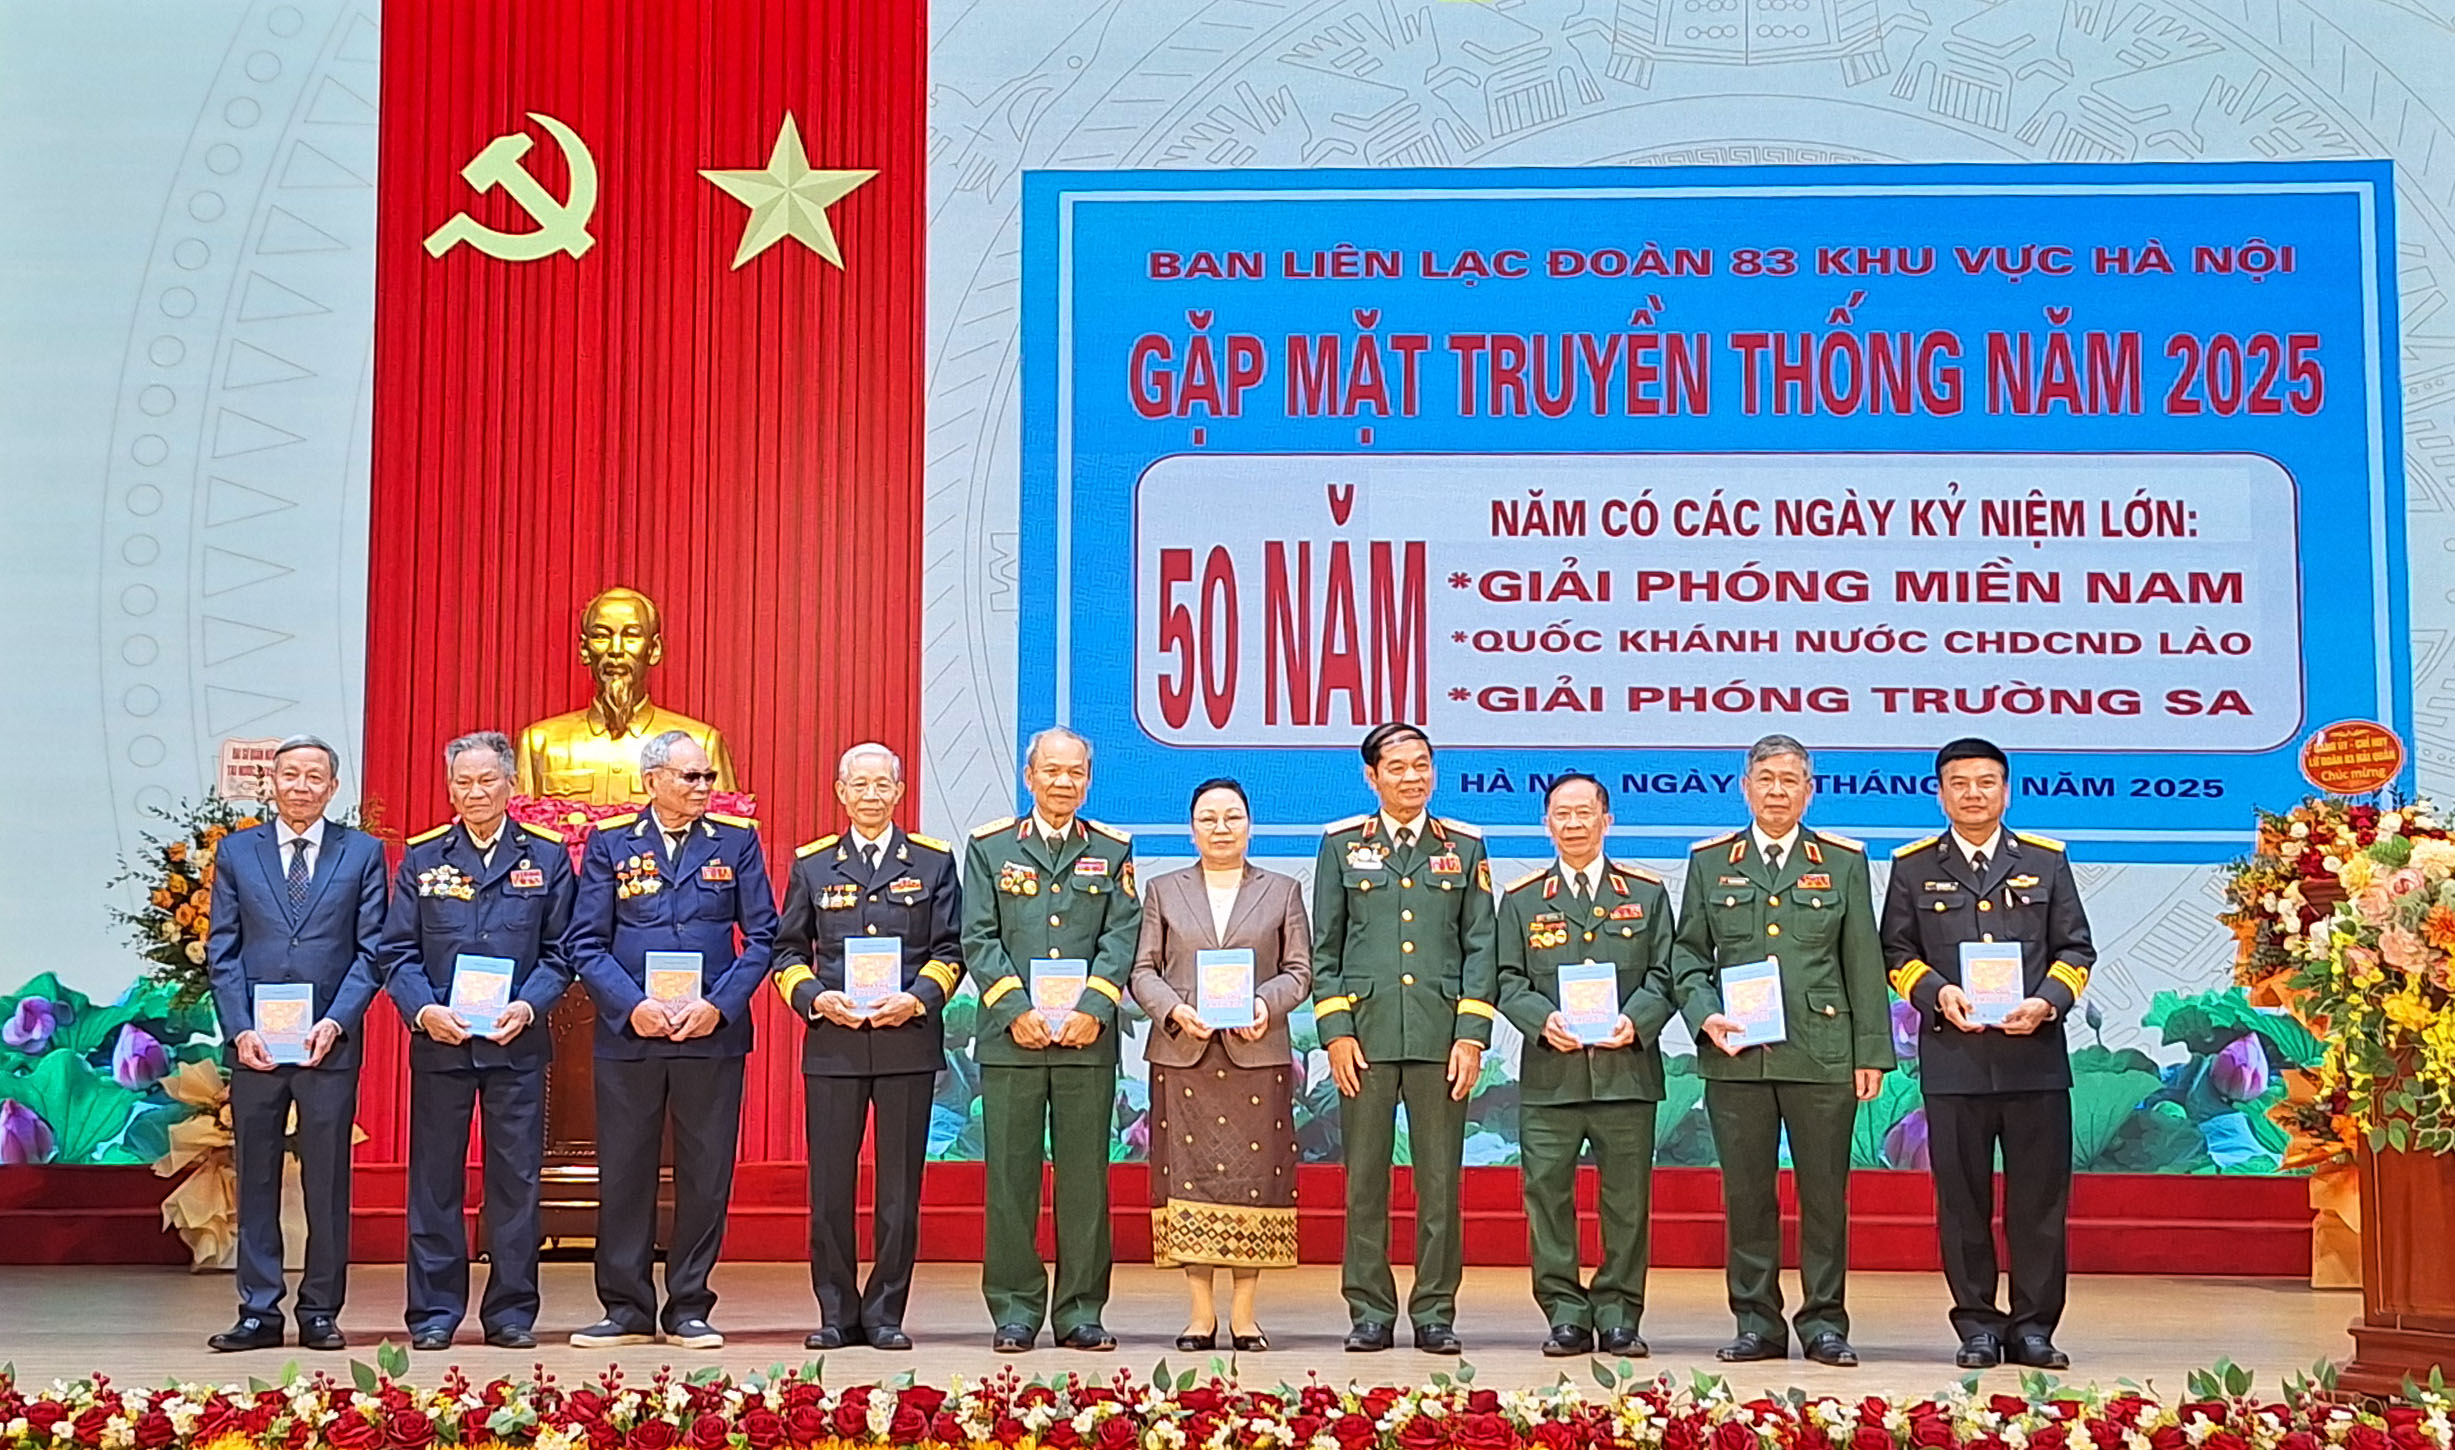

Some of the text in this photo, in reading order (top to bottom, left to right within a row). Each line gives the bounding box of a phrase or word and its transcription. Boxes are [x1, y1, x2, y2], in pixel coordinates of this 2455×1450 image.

[1149, 238, 2295, 286] BAN LIÊN LẠC ĐOÀN 83 KHU VỰC HÀ NỘI
[1129, 291, 2326, 445] GẶP MẶT TRUYỀN THỐNG NĂM 2025
[1491, 482, 2199, 548] NĂM CÓ CÁC NGÀY KỶ NIỆM LỚN:
[1636, 561, 1871, 604] PHÓNG
[1895, 556, 2062, 604] MIỀN
[2086, 571, 2245, 605] NAM
[1157, 484, 1428, 730] 50 NĂM
[1619, 622, 1780, 654] KHÁNH
[1796, 623, 1929, 655] NƯỚC
[1943, 630, 2143, 656] CHDCND
[2157, 624, 2253, 657] LÀO
[1628, 679, 1852, 715] PHÓNG
[1872, 682, 2142, 717] TRƯỜNG
[2165, 689, 2255, 717] SA
[1460, 768, 1514, 793] HÀ
[1622, 769, 1735, 794] NGÀY
[2022, 770, 2116, 797] NĂM
[2130, 777, 2225, 798] 2025
[2321, 766, 2387, 782] Chúc mừng
